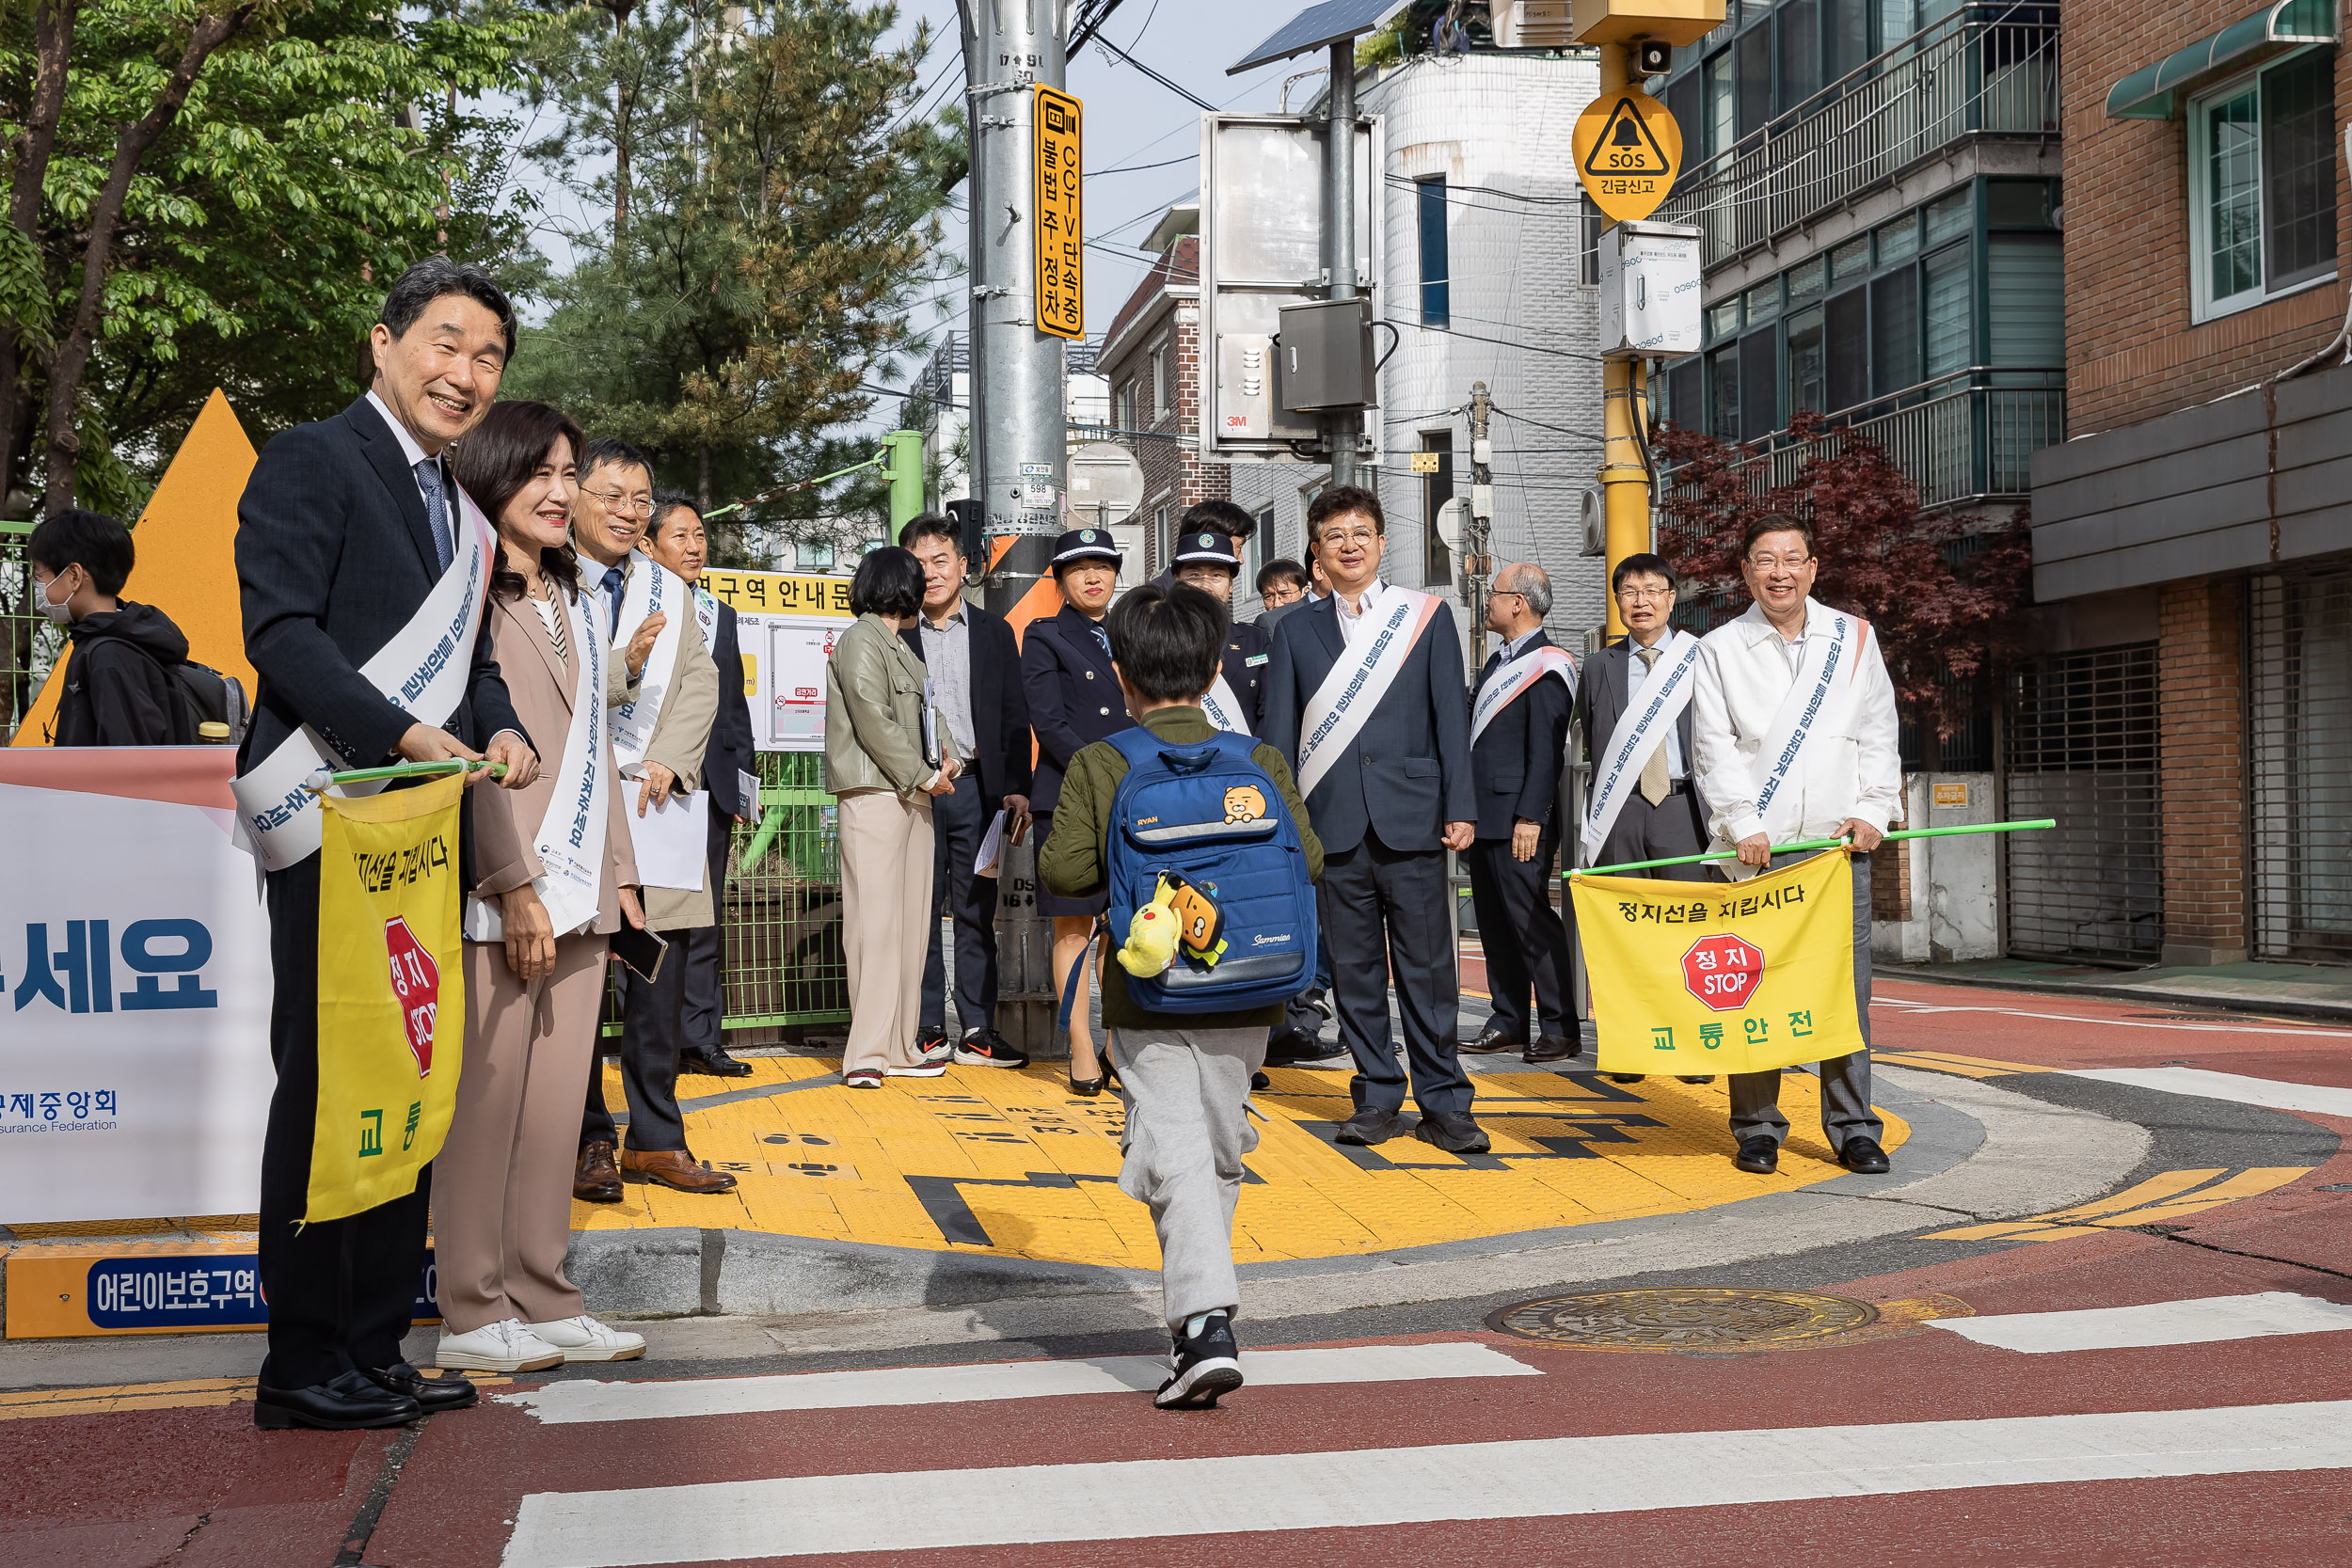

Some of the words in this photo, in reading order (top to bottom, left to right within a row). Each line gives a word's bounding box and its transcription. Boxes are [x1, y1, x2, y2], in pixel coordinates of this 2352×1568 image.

[1043, 137, 1058, 202] 불법
[1609, 153, 1645, 167] SOS
[1601, 179, 1655, 195] 긴급신고
[1226, 416, 1247, 427] 3M
[1030, 484, 1047, 494] 598
[779, 580, 850, 611] 안내문
[1387, 603, 1410, 631] 소중한
[400, 634, 455, 704] 등하굣길
[1362, 629, 1394, 670] 아이들의
[1820, 641, 1842, 685] 아이들의
[1335, 667, 1370, 714] 등하굣길
[1660, 662, 1689, 698] 아이들의
[1635, 695, 1665, 736] 등하굣길
[1799, 683, 1828, 730] 등하굣길
[1306, 710, 1341, 752] 안전하게
[1613, 733, 1641, 773] 안전하게
[1772, 728, 1806, 778] 안전하게
[568, 760, 596, 849] 지켜주세요
[1592, 771, 1619, 821] 지켜주세요
[1136, 816, 1158, 826] RYAN
[399, 835, 449, 887] 지킵시다
[1003, 894, 1021, 908] 16
[1014, 879, 1035, 891] DS
[1618, 901, 1708, 924] 정지선을
[1718, 884, 1805, 920] 지킵시다
[0, 918, 218, 1014] 세요
[1704, 972, 1748, 995] STOP
[410, 1002, 437, 1046] STOP
[51, 1119, 117, 1132] Federation
[97, 1269, 255, 1312] 어린이보호구역
